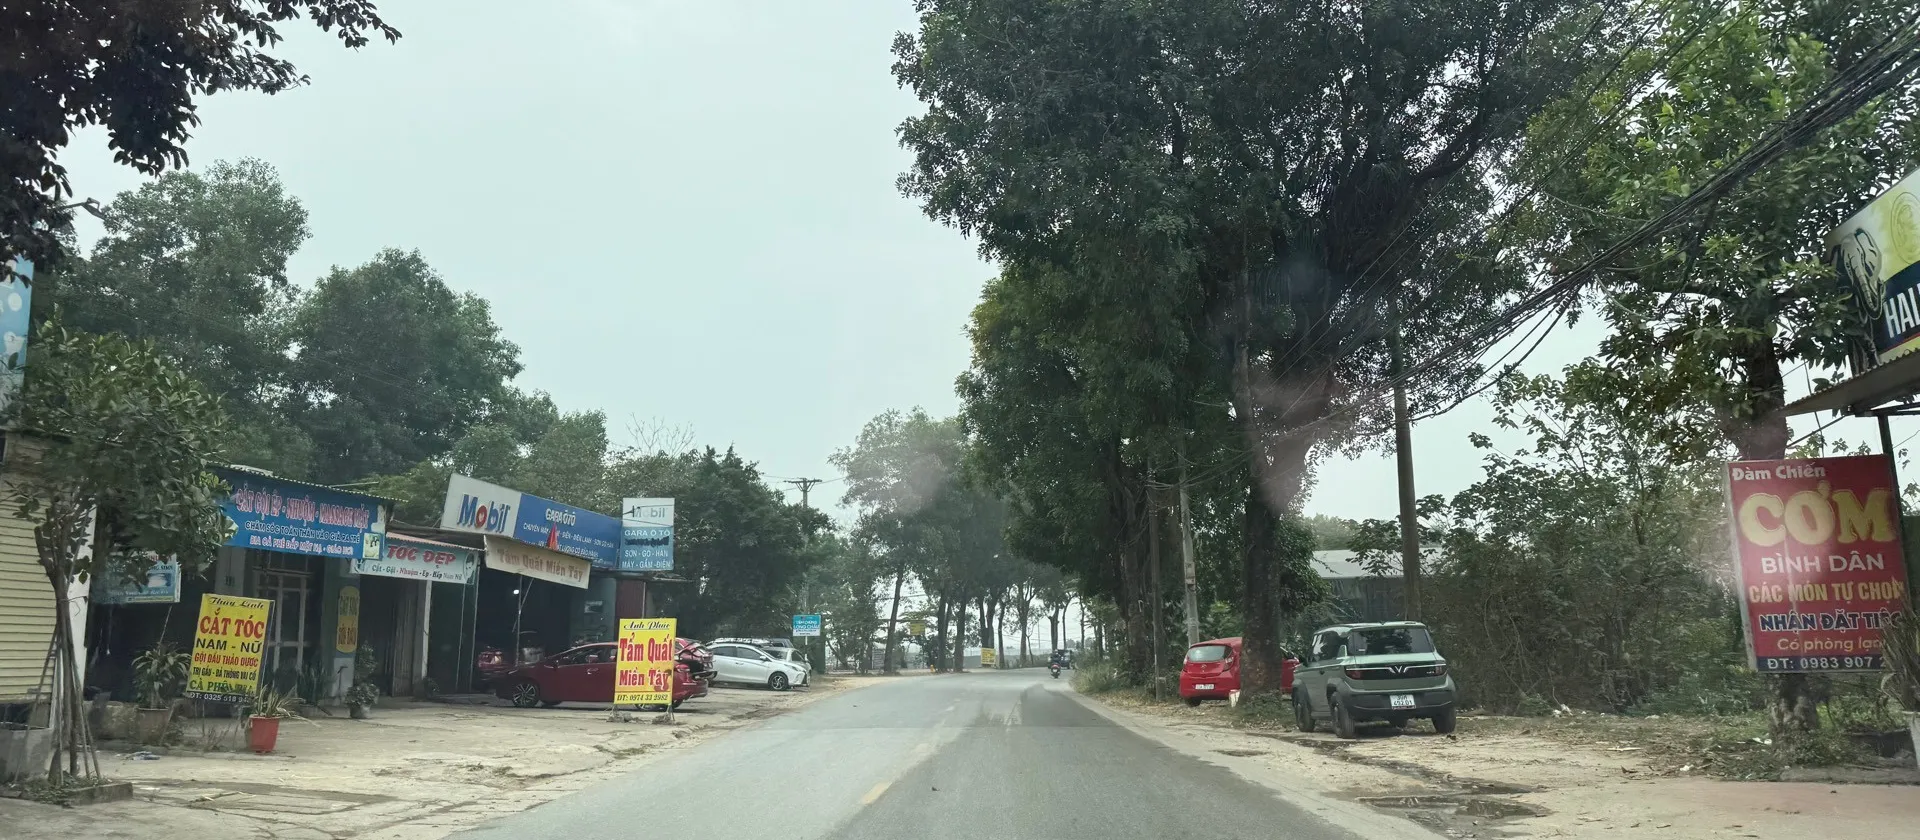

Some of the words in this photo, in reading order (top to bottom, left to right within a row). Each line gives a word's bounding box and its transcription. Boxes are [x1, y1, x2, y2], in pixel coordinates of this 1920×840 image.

[1883, 282, 1920, 338] HAL
[1732, 466, 1772, 481] Đàm
[1776, 462, 1825, 479] Chiến
[457, 494, 510, 533] Mobil
[545, 508, 562, 524] GARA
[1738, 480, 1898, 547] CƠM
[422, 549, 457, 569] ĐẸP
[1762, 553, 1821, 574] BÌNH
[1829, 551, 1884, 572] DÂN
[1750, 584, 1783, 603] CÁC
[1789, 580, 1827, 601] MÓN
[1832, 583, 1853, 604] TỰ
[200, 608, 231, 636] CẮT
[235, 615, 264, 639] TÓC
[1759, 610, 1817, 634] NHẬN
[1821, 608, 1860, 634] ĐẶT
[196, 638, 227, 650] NAM
[240, 640, 262, 653] NỮ
[620, 632, 644, 661] Tẩm
[648, 634, 672, 664] Quất
[1777, 637, 1800, 651] Có
[1804, 635, 1853, 652] phòng
[195, 651, 206, 664] GỘI
[223, 653, 239, 665] THẢO
[1767, 658, 1794, 669] ĐT:
[1801, 657, 1839, 669] 0983
[1845, 656, 1873, 668] 907
[190, 678, 203, 690] CÀ
[619, 667, 645, 686] Miền
[648, 668, 669, 690] Tây
